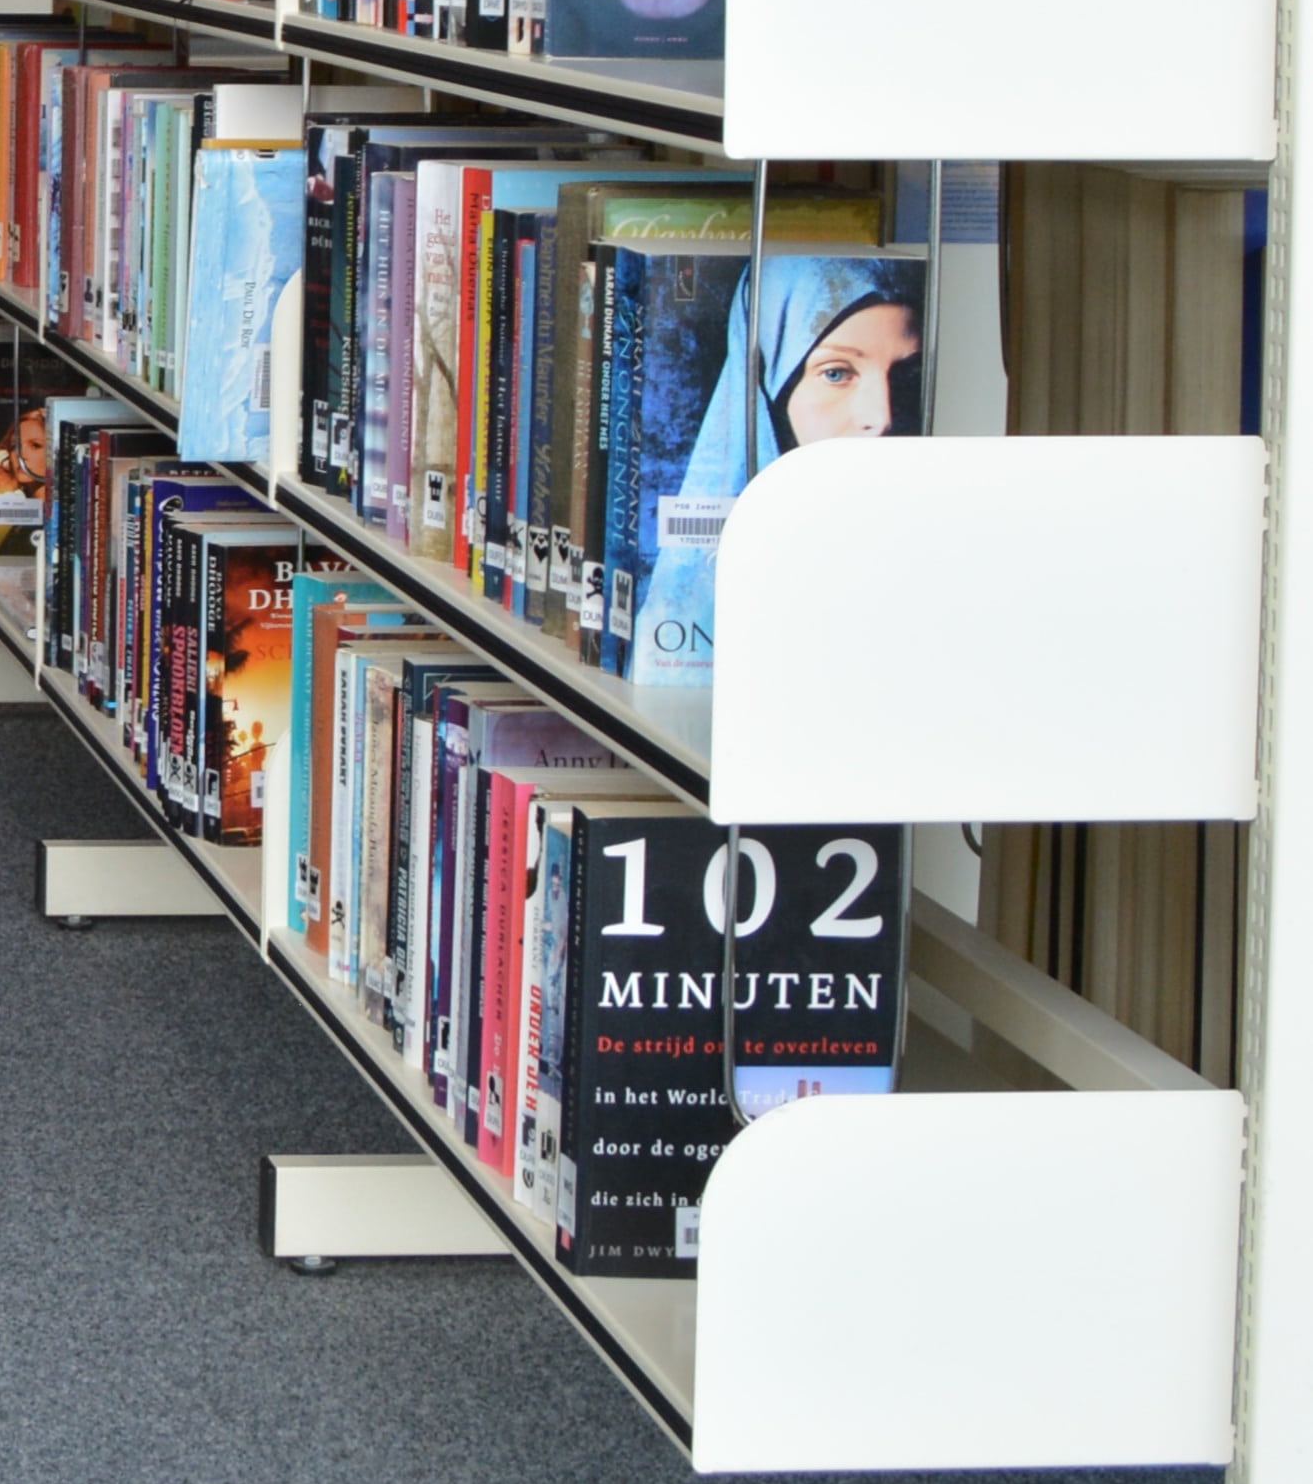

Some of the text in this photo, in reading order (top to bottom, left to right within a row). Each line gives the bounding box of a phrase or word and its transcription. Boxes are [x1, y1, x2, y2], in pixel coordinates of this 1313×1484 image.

[600, 266, 615, 305] SARAH
[600, 307, 615, 357] DUNANT
[599, 361, 614, 401] ONDER
[600, 837, 884, 940] 102
[597, 971, 883, 1011] MINUTEN
[597, 1035, 880, 1059] De strijd te overleven
[594, 1087, 660, 1106] in het
[592, 1139, 676, 1157] door de
[590, 1190, 690, 1207] die zich in
[588, 1242, 623, 1259] JIM
